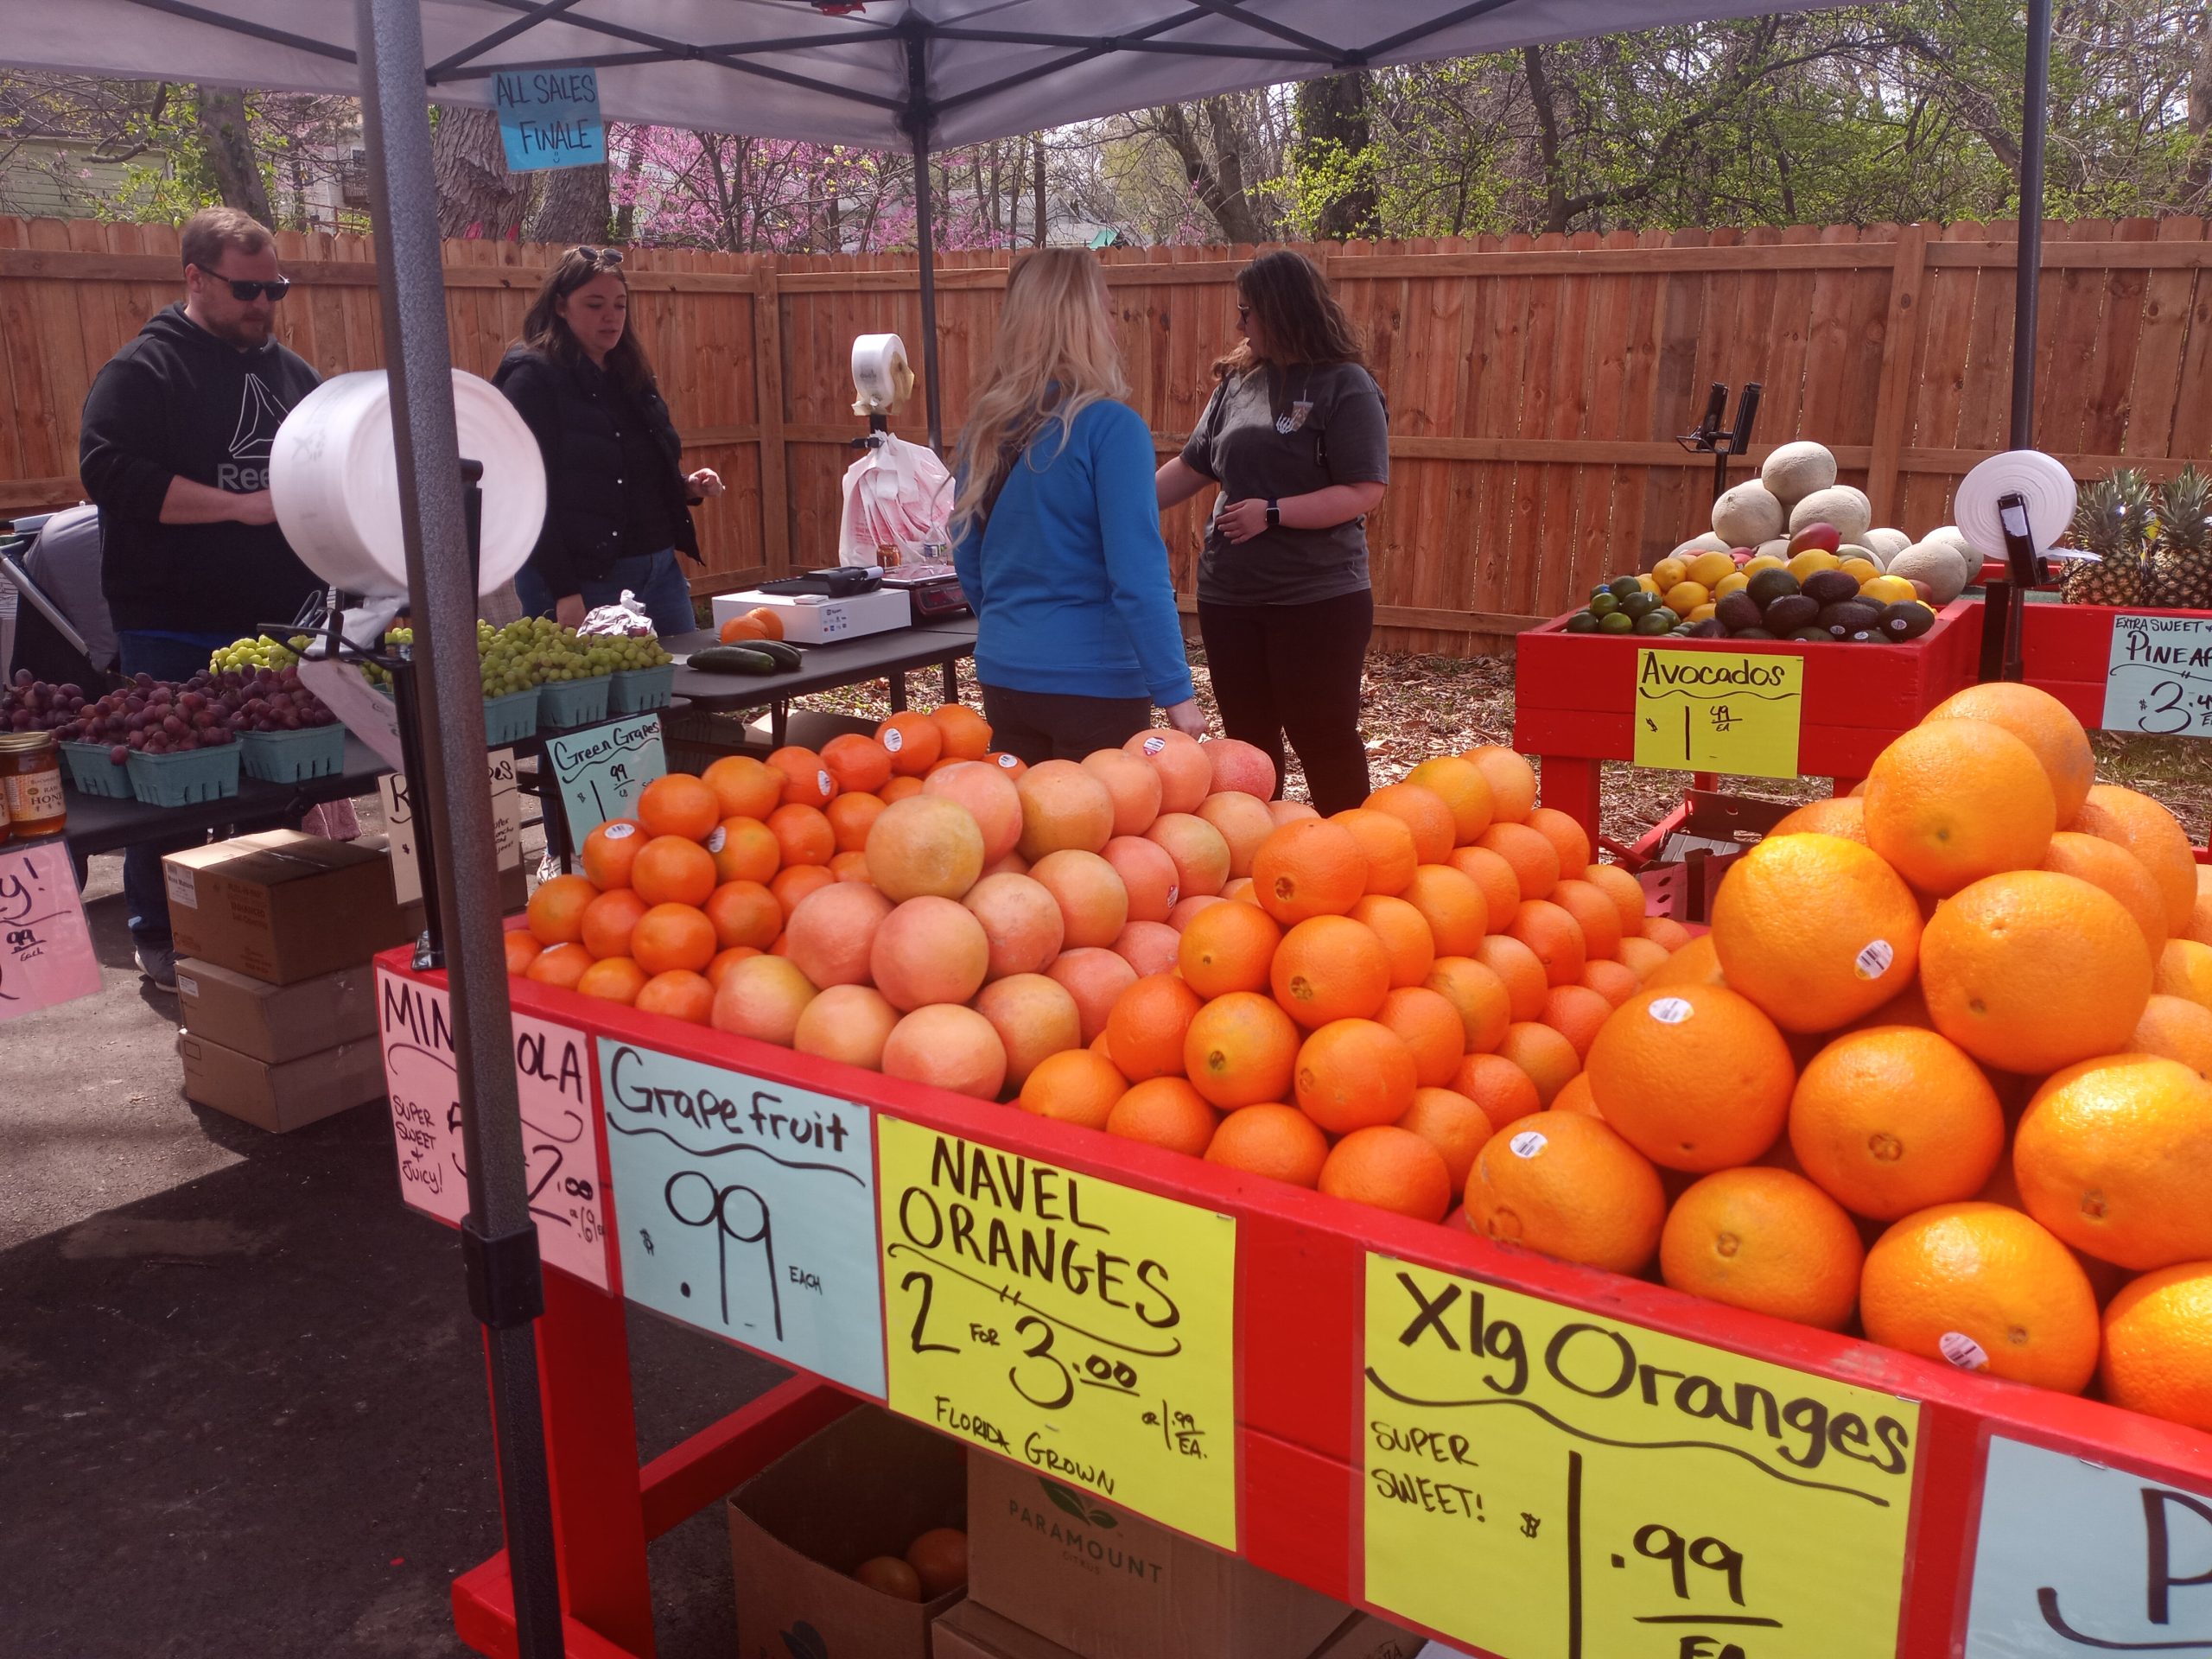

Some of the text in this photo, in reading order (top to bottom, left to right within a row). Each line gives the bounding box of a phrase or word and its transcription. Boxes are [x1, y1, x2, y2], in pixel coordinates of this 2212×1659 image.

[496, 73, 596, 108] ALL SALES
[519, 118, 592, 154] FINALE
[217, 462, 270, 491] Ree
[2115, 616, 2148, 631] EXTRA
[2150, 619, 2204, 633] SWEET
[1642, 651, 1786, 687] Avocados
[1716, 723, 1730, 732] EA
[2202, 715, 2212, 727] E
[554, 740, 613, 771] Green
[30, 793, 63, 805] HONE
[20, 948, 45, 962] Each
[385, 977, 584, 1105] MINOLA
[392, 1095, 436, 1128] SUPER
[394, 1121, 437, 1151] SWEET
[931, 1135, 1110, 1235] NAVEL
[899, 1185, 1180, 1329] ORANGES
[788, 1265, 823, 1295] EACH
[900, 1270, 961, 1355] 2
[969, 1321, 1001, 1347] FOR
[1544, 1322, 1910, 1476] Oranges
[934, 1395, 1115, 1496] FLORIDA GROWN
[1370, 1420, 1479, 1468] SUPER
[1370, 1467, 1486, 1524] SWEET!
[1008, 1498, 1163, 1585] PARAMOUNT
[1062, 1549, 1101, 1576] CITRUS
